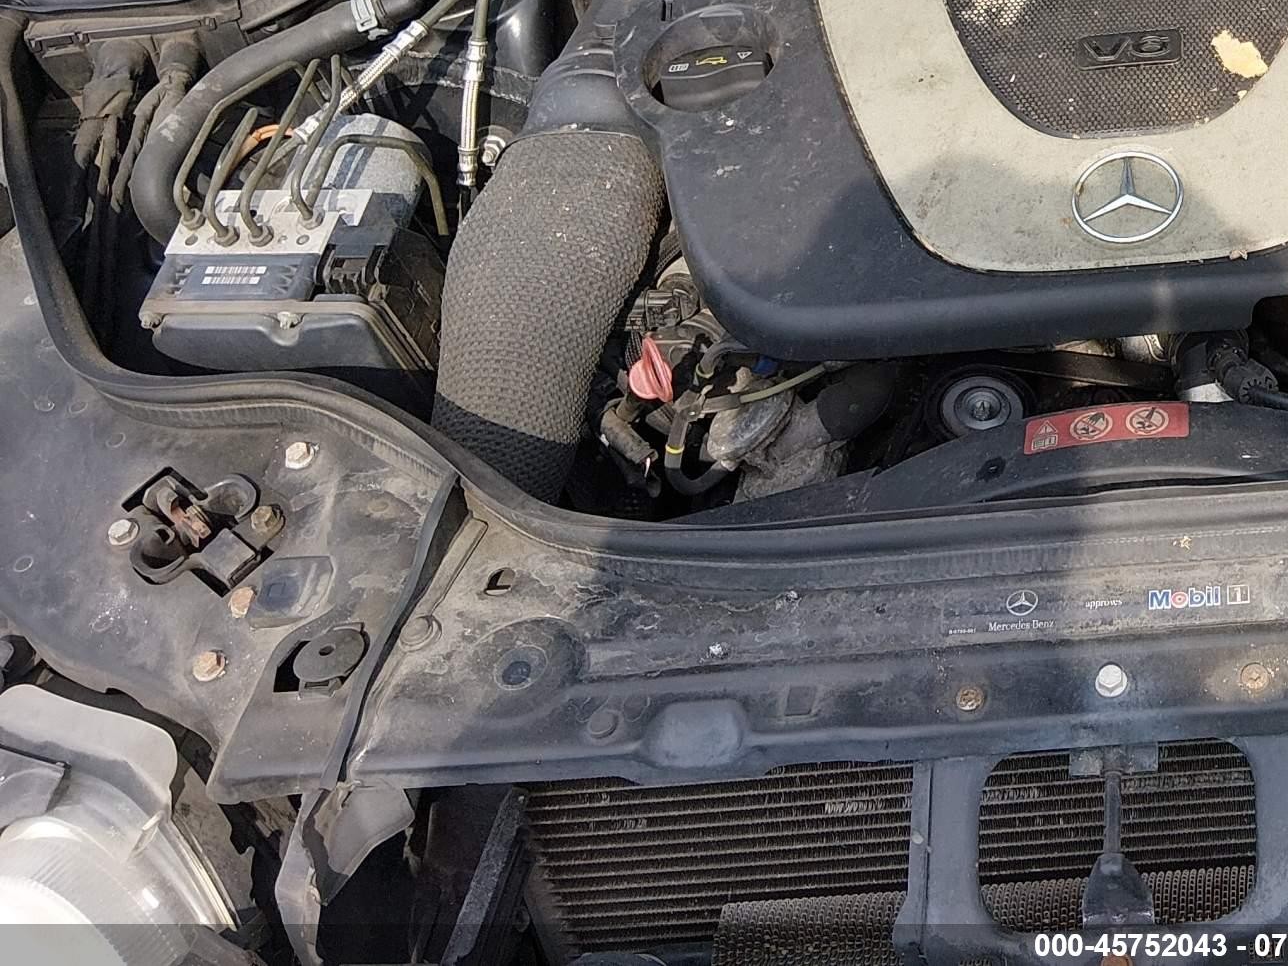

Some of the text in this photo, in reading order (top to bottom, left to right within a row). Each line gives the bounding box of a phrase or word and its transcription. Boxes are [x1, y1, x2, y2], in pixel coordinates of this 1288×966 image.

[1083, 34, 1172, 62] V6
[1085, 598, 1123, 611] approves
[1148, 585, 1221, 611] Mobil
